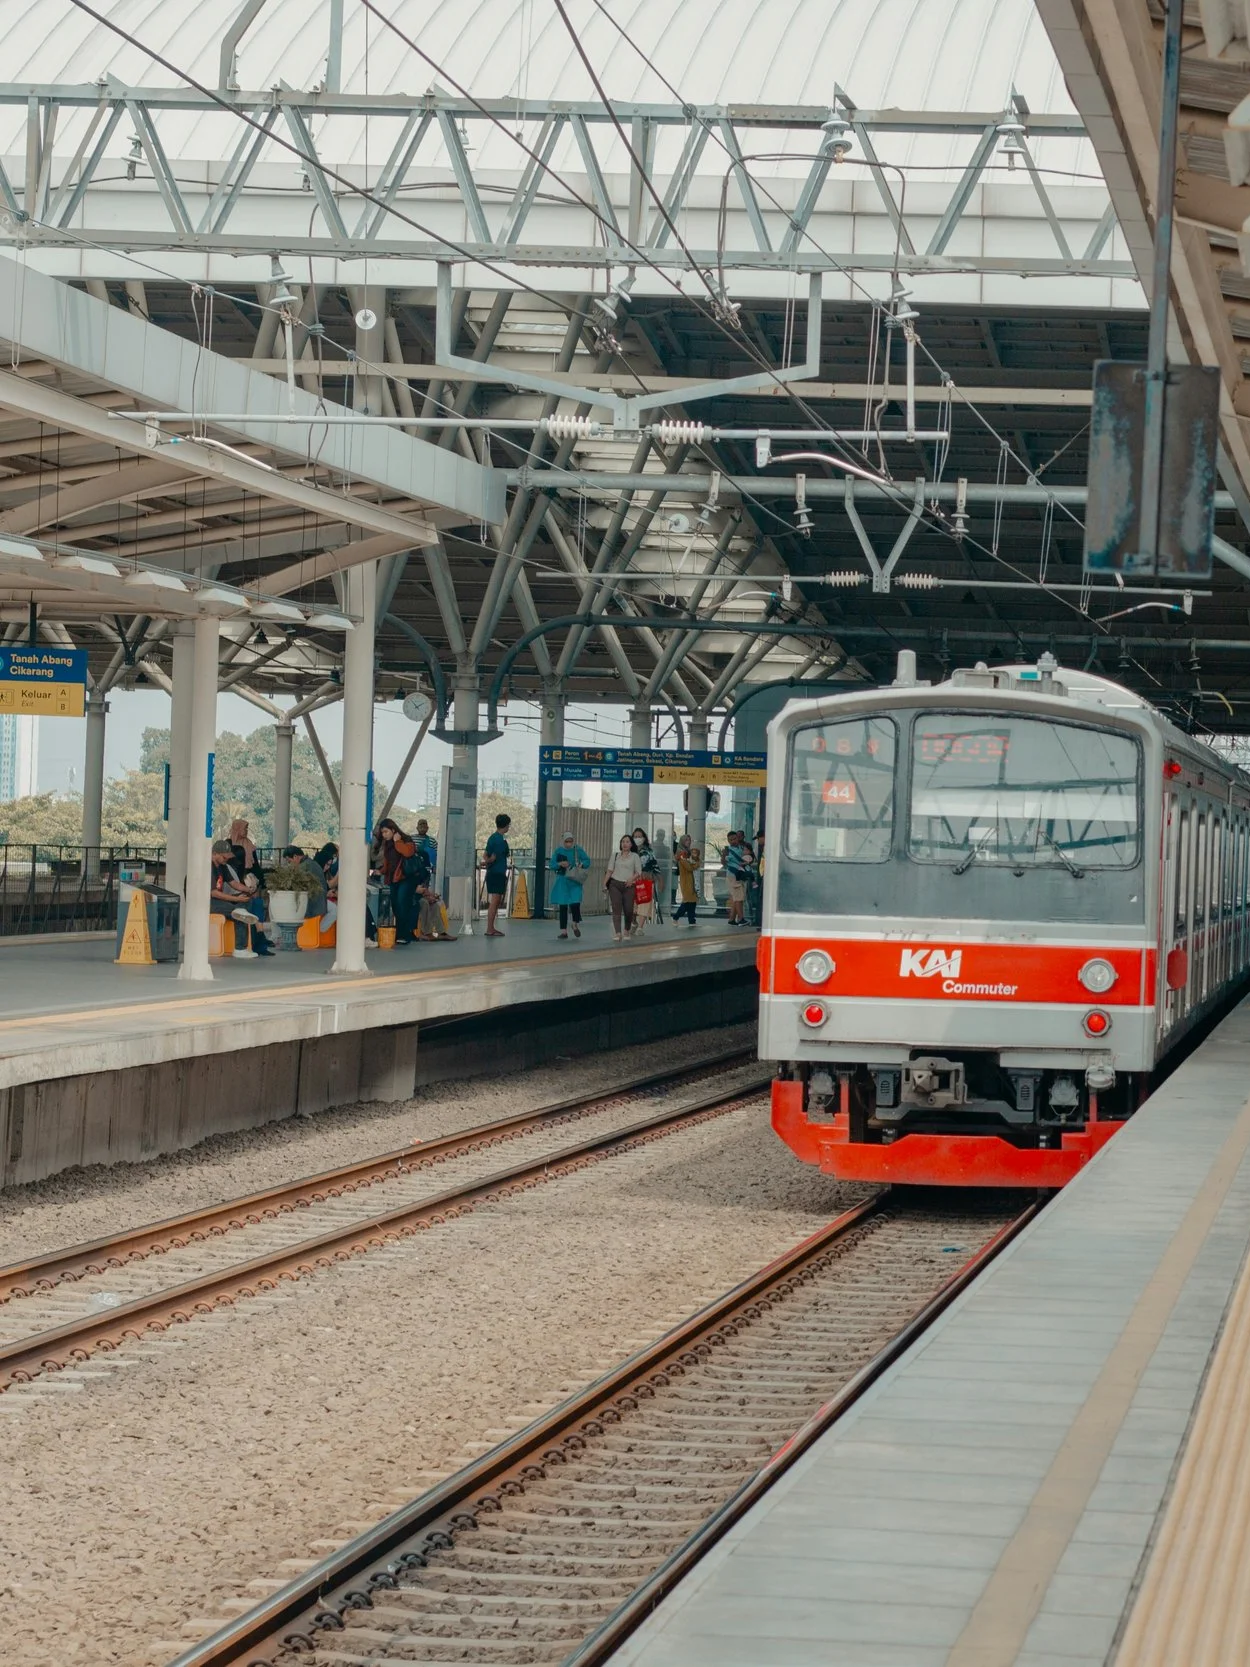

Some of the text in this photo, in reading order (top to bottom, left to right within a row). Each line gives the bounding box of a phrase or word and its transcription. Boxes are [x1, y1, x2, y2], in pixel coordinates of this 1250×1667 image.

[10, 653, 73, 667] Tanah Abang
[9, 665, 54, 678] Cikarang
[21, 689, 67, 699] Keluar A
[60, 703, 66, 711] B
[828, 786, 850, 798] 44
[899, 949, 963, 978] KAI
[942, 979, 1019, 996] Commuter
